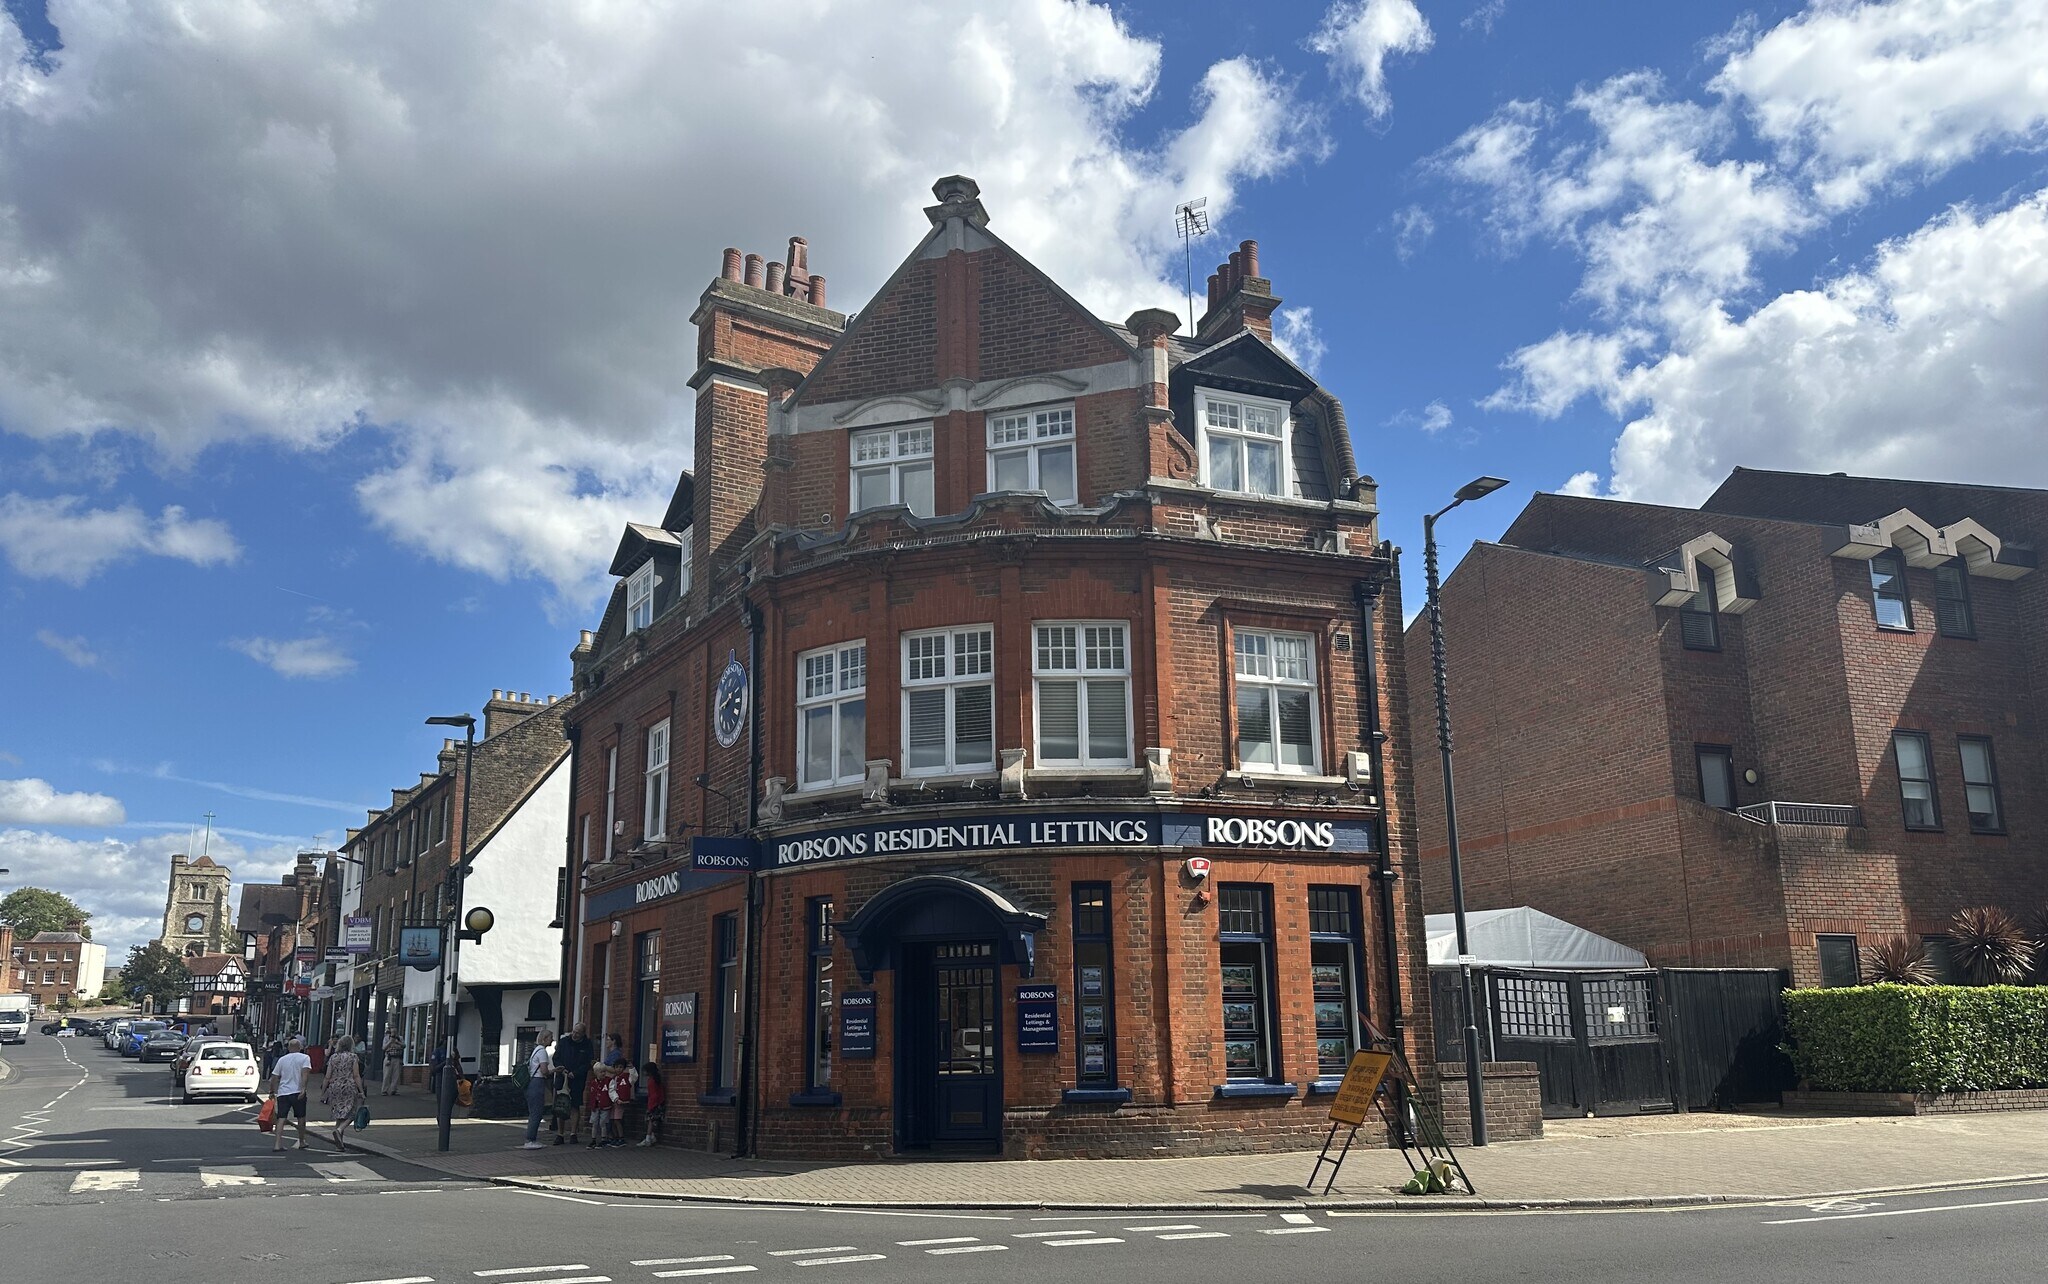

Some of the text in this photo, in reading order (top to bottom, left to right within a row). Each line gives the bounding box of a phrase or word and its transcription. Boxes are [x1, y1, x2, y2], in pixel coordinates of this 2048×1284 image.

[1207, 817, 1335, 847] ROBSONS
[778, 820, 1148, 864] ROBSONS RESIDENTIAL LETTINGS
[697, 854, 750, 867] ROBSONS
[635, 871, 679, 904] ROBSONS
[843, 997, 872, 1005] ROBSONS
[1020, 991, 1055, 999] ROBSONS
[665, 1000, 692, 1016] ROBSONS
